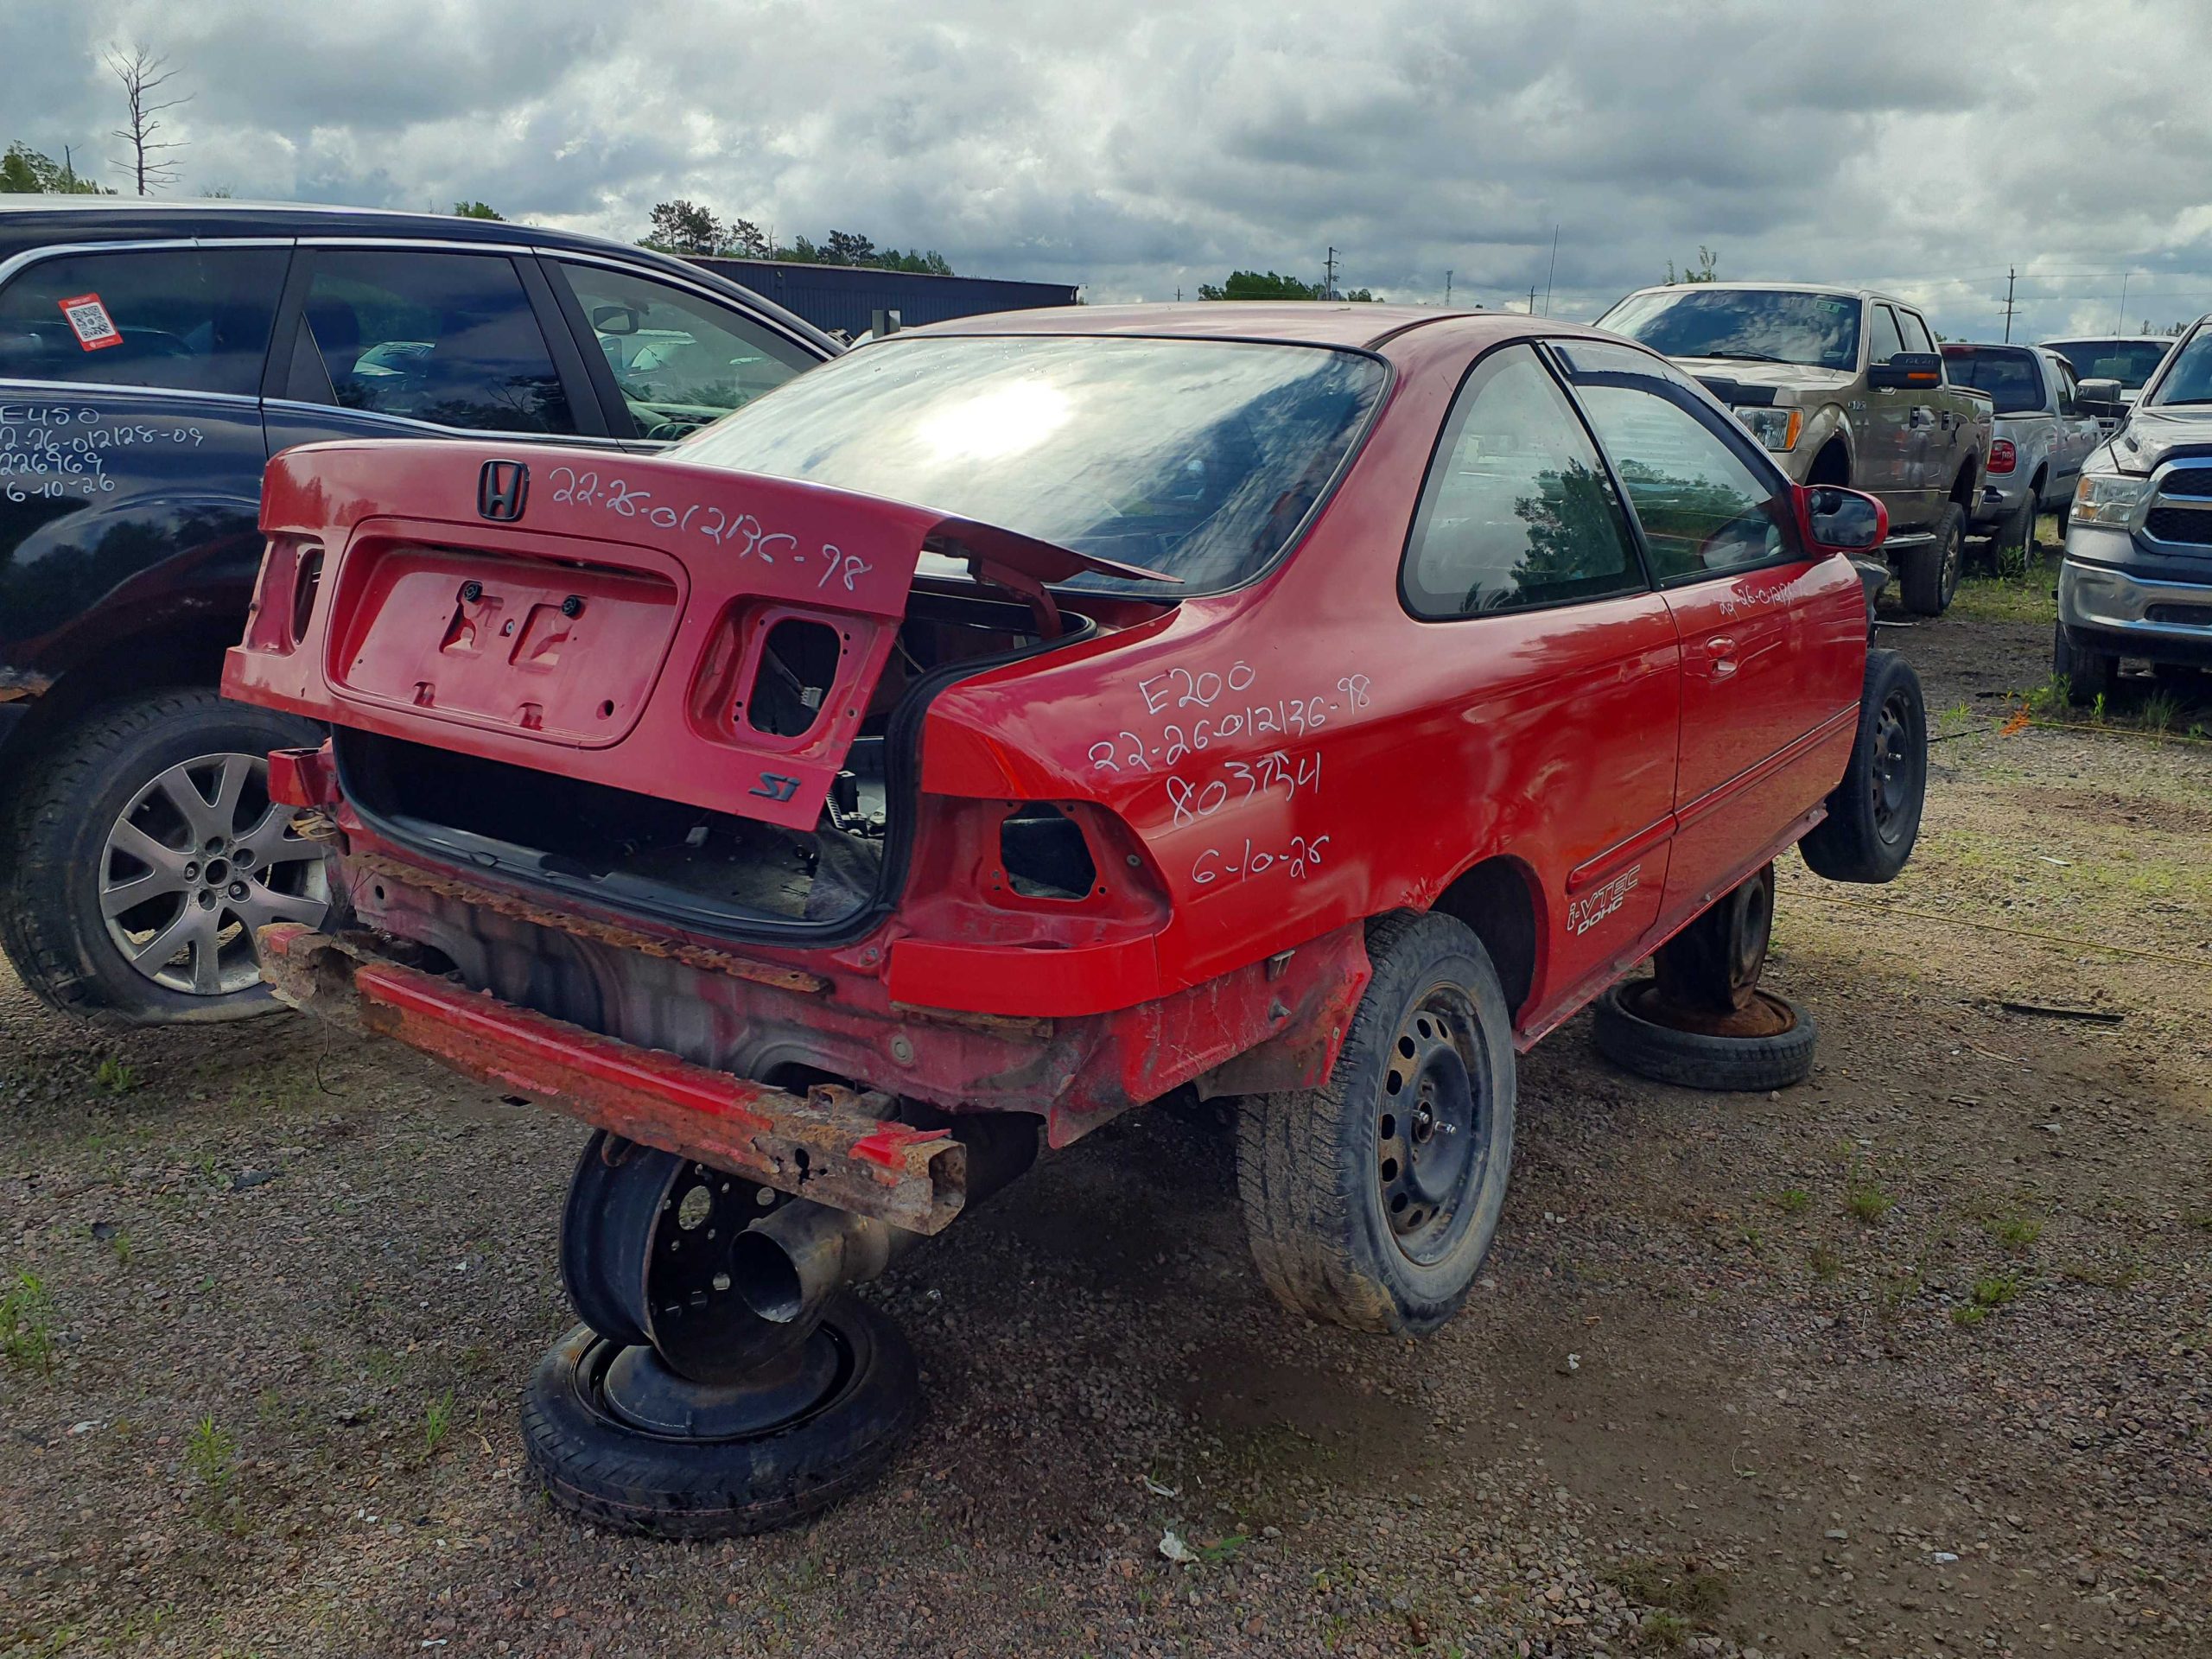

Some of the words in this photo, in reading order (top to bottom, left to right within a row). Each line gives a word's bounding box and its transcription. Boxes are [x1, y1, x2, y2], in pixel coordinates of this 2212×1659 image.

[0, 404, 100, 426] E450
[0, 425, 204, 453] 2-26-012128-09
[6, 473, 115, 502] 6-10-26
[1139, 660, 1255, 715] E200
[748, 772, 802, 803] Si
[1567, 864, 1641, 931] i-VTEC
[1577, 895, 1624, 937] DOHC
